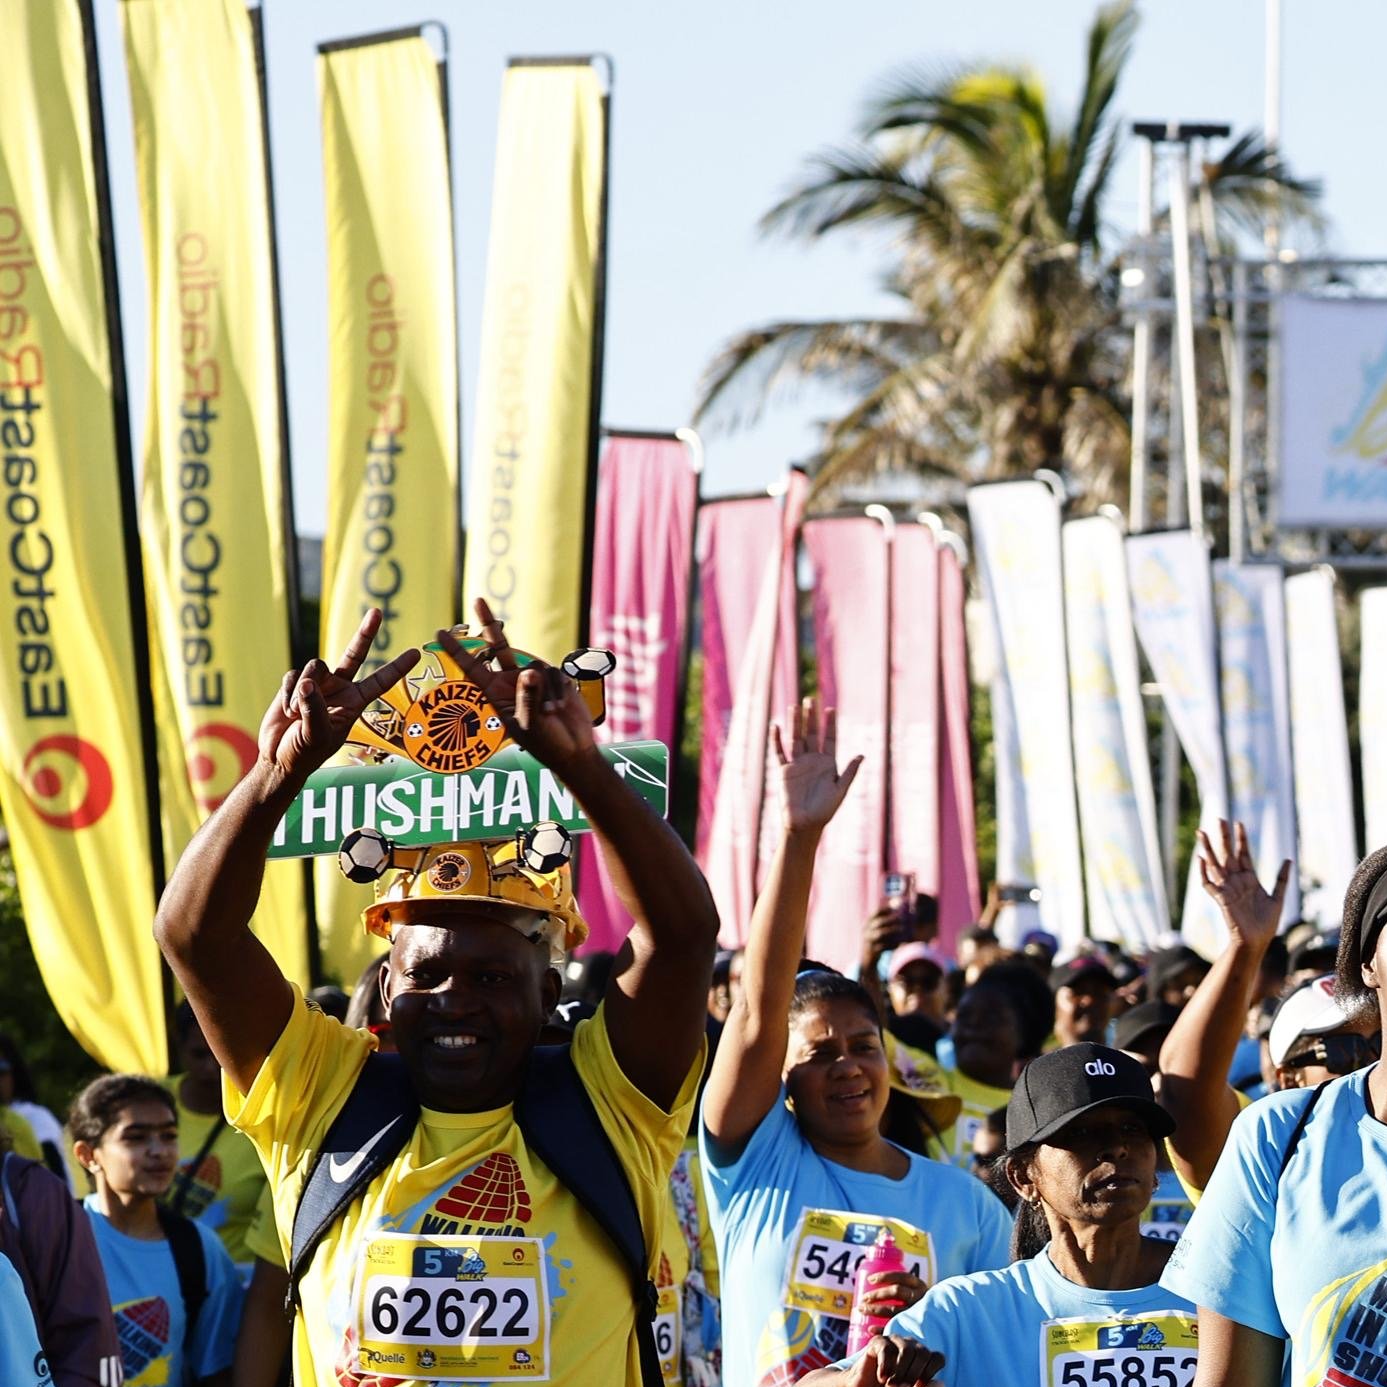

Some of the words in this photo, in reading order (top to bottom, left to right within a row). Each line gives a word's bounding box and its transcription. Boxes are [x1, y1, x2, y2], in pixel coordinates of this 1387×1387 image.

[420, 683, 489, 716] KAIZER
[415, 742, 492, 772] CHIEFS
[1085, 1059, 1116, 1076] alo
[852, 1225, 867, 1243] 5
[424, 1250, 443, 1275] 5
[372, 1286, 529, 1337] 62622
[1107, 1327, 1124, 1346] 5
[1346, 1303, 1385, 1348] IN
